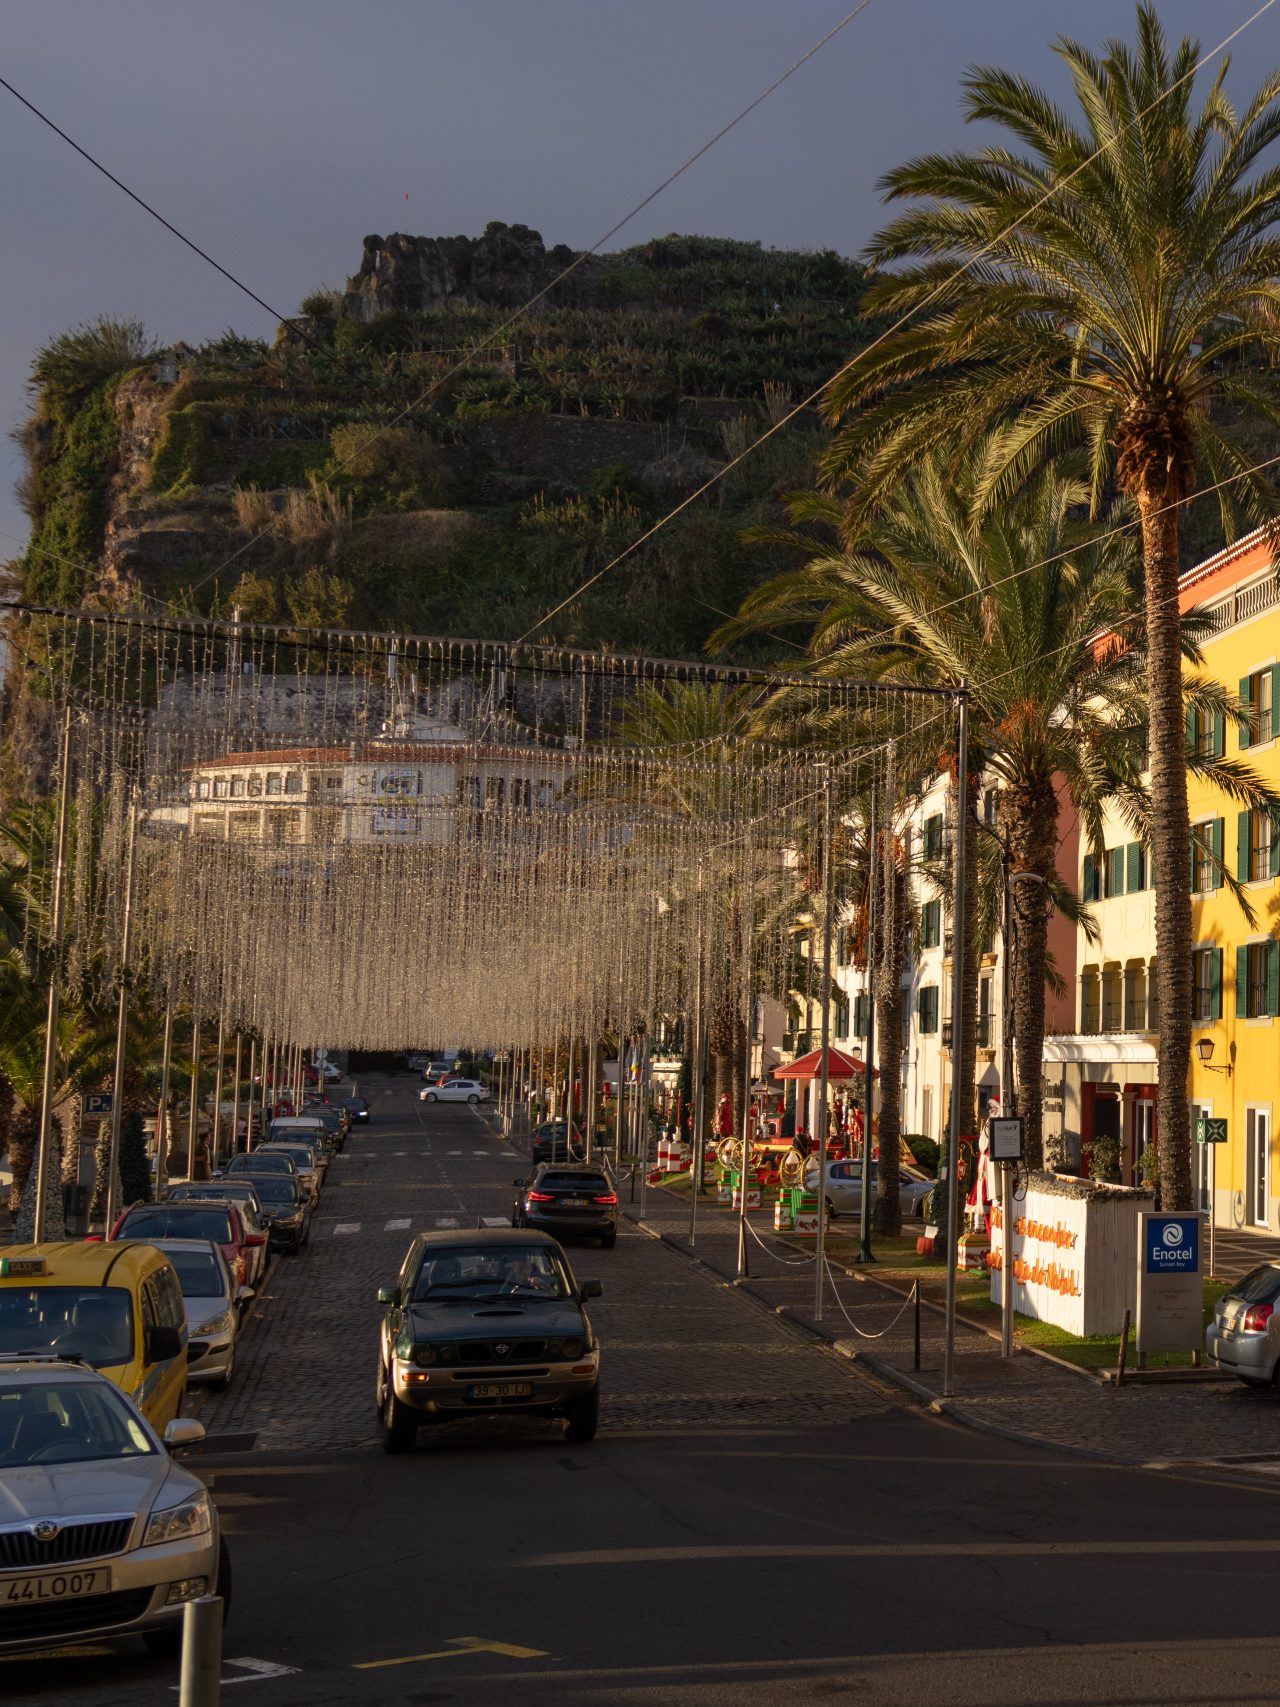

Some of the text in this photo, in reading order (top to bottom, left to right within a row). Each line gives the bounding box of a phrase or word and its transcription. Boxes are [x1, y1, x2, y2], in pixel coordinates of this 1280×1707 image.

[90, 1097, 102, 1111] P
[1153, 1246, 1192, 1260] Enotel
[10, 1262, 32, 1272] TAXI
